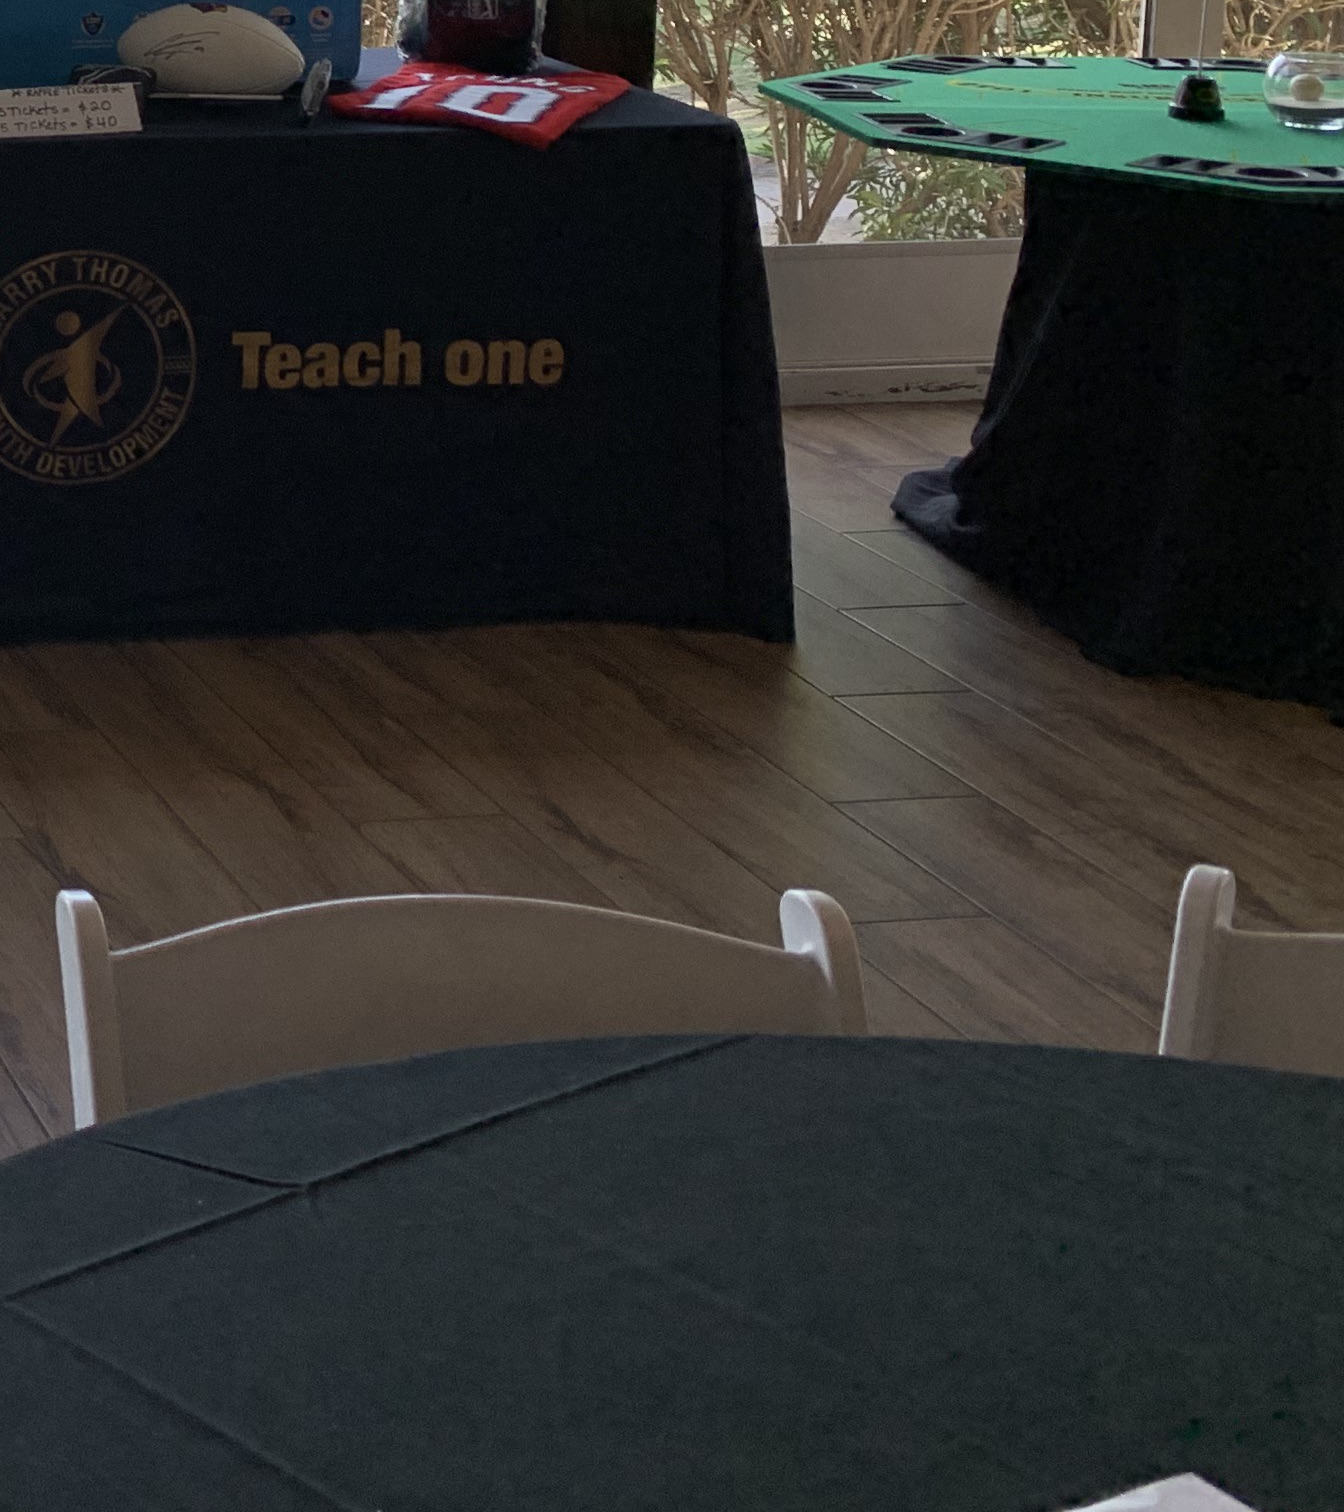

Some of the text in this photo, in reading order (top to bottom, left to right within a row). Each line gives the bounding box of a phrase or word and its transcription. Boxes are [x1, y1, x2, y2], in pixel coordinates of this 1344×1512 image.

[72, 257, 180, 328] THOMAS
[231, 327, 565, 390] Teach one
[35, 387, 185, 477] DEVELOPMENT
